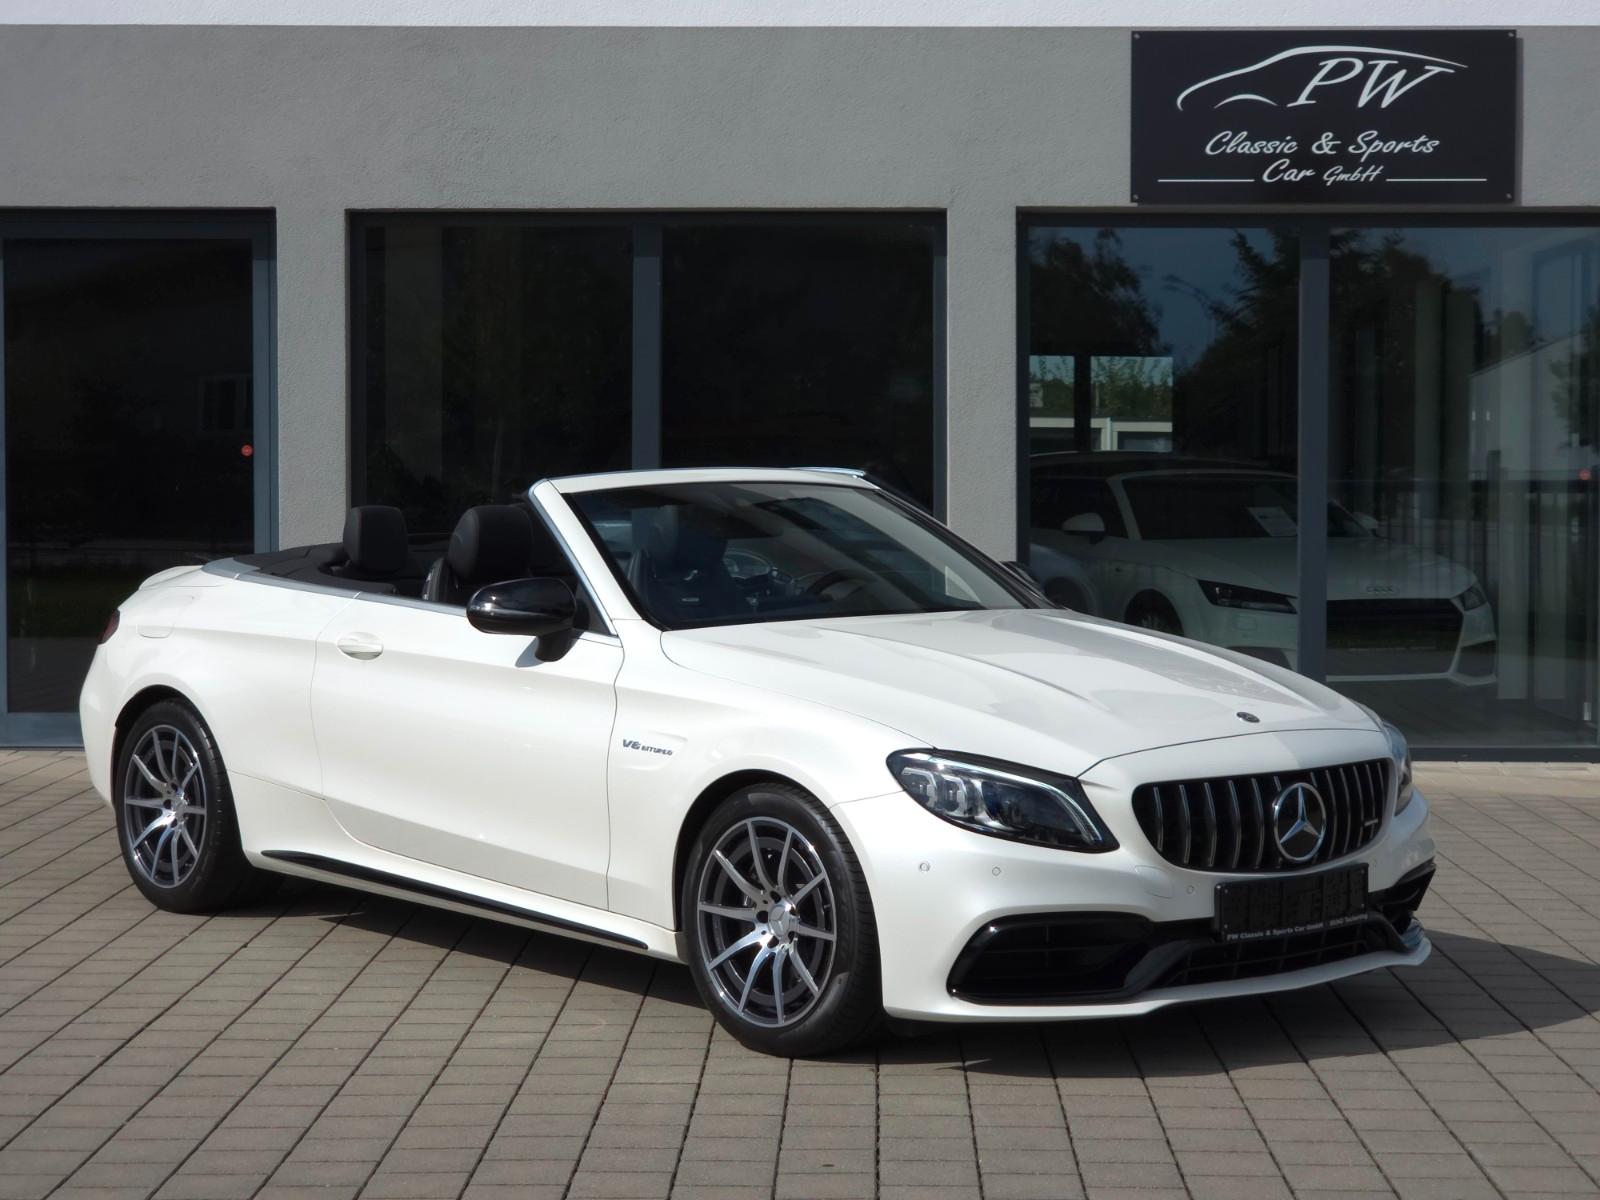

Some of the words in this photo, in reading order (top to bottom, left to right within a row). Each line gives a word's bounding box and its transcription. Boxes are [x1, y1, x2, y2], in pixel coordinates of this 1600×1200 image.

[1286, 57, 1456, 109] PW
[1204, 130, 1298, 156] Classic
[1311, 131, 1342, 155] &
[1347, 129, 1441, 163] Sports
[1262, 158, 1316, 183] Car
[1322, 165, 1384, 187] GmbH
